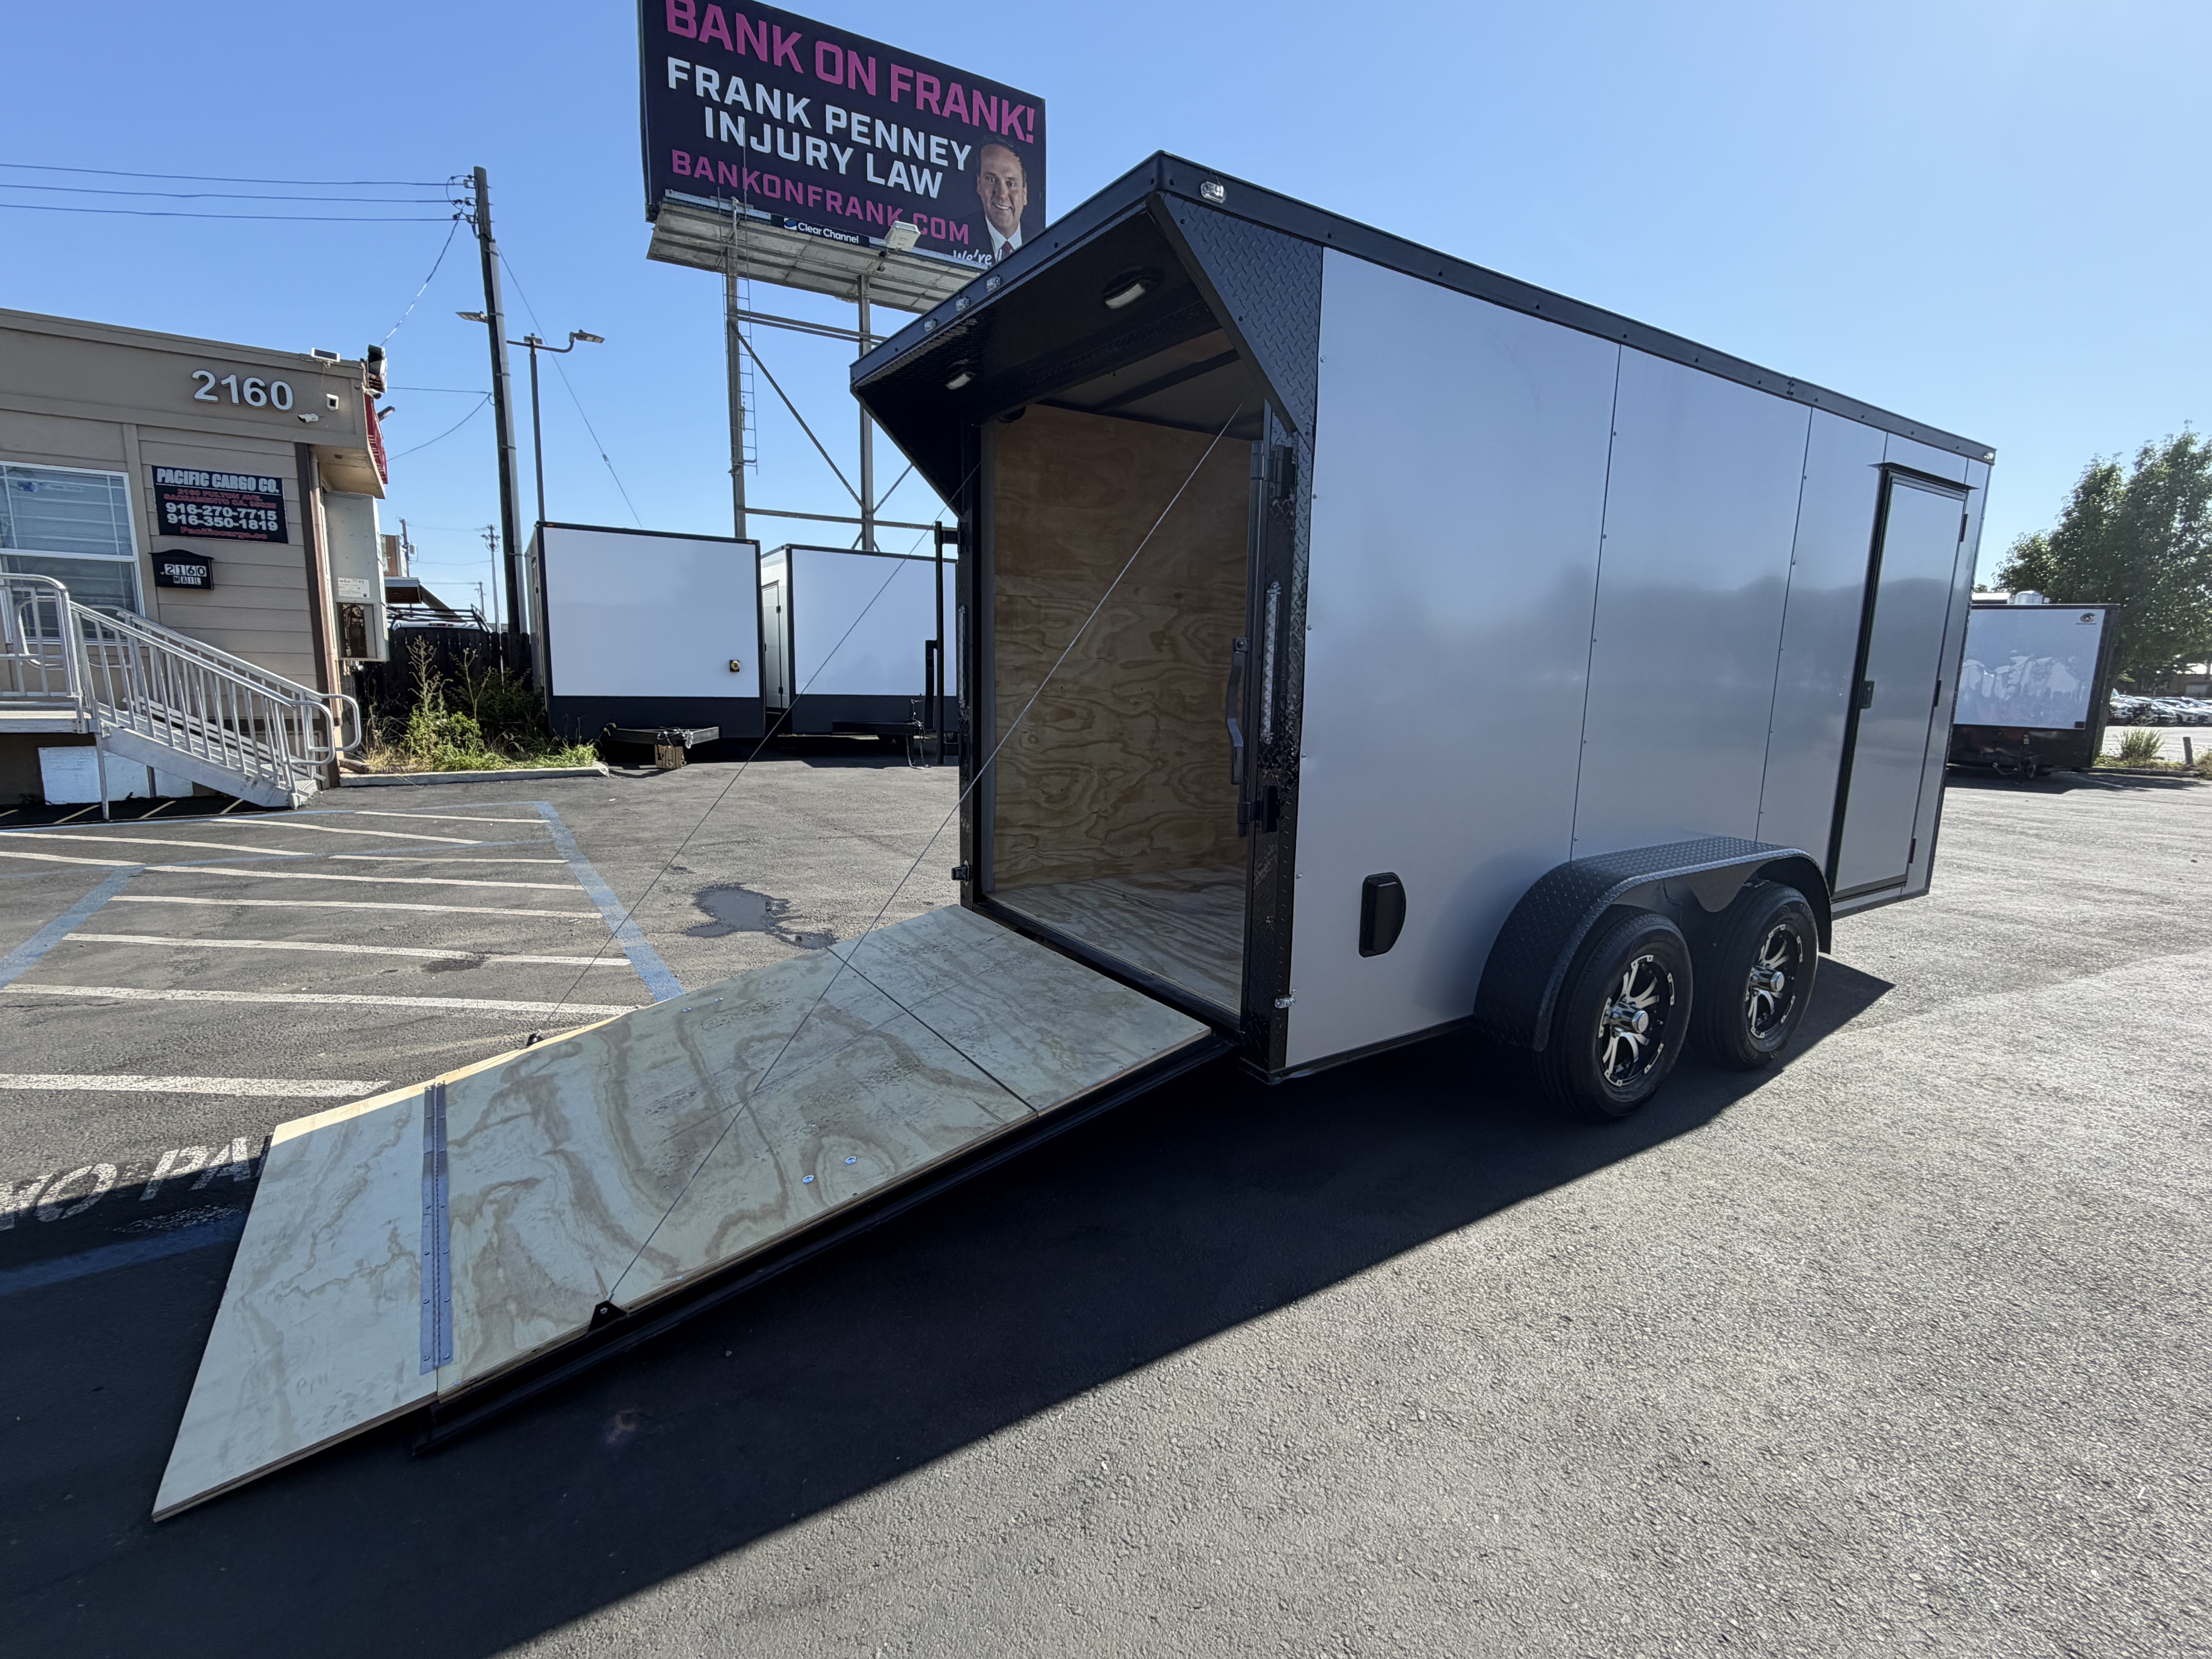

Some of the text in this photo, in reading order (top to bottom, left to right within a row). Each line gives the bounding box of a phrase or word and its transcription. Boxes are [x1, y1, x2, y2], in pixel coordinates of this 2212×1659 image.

[666, 0, 1035, 144] BANK ON FRANK!
[668, 56, 972, 171] FRANK PENNEY
[705, 106, 943, 199] INJURY LAW
[672, 149, 968, 245] BANKONFRANKCOM
[798, 222, 859, 244] Clear Channel
[192, 370, 293, 410] 2160
[156, 468, 279, 493] PACIFIC CARGO CO.
[165, 502, 277, 520] 916-270-7715
[167, 514, 278, 531] 916-350-1819
[166, 565, 205, 576] 2160
[174, 576, 200, 585] MAIL
